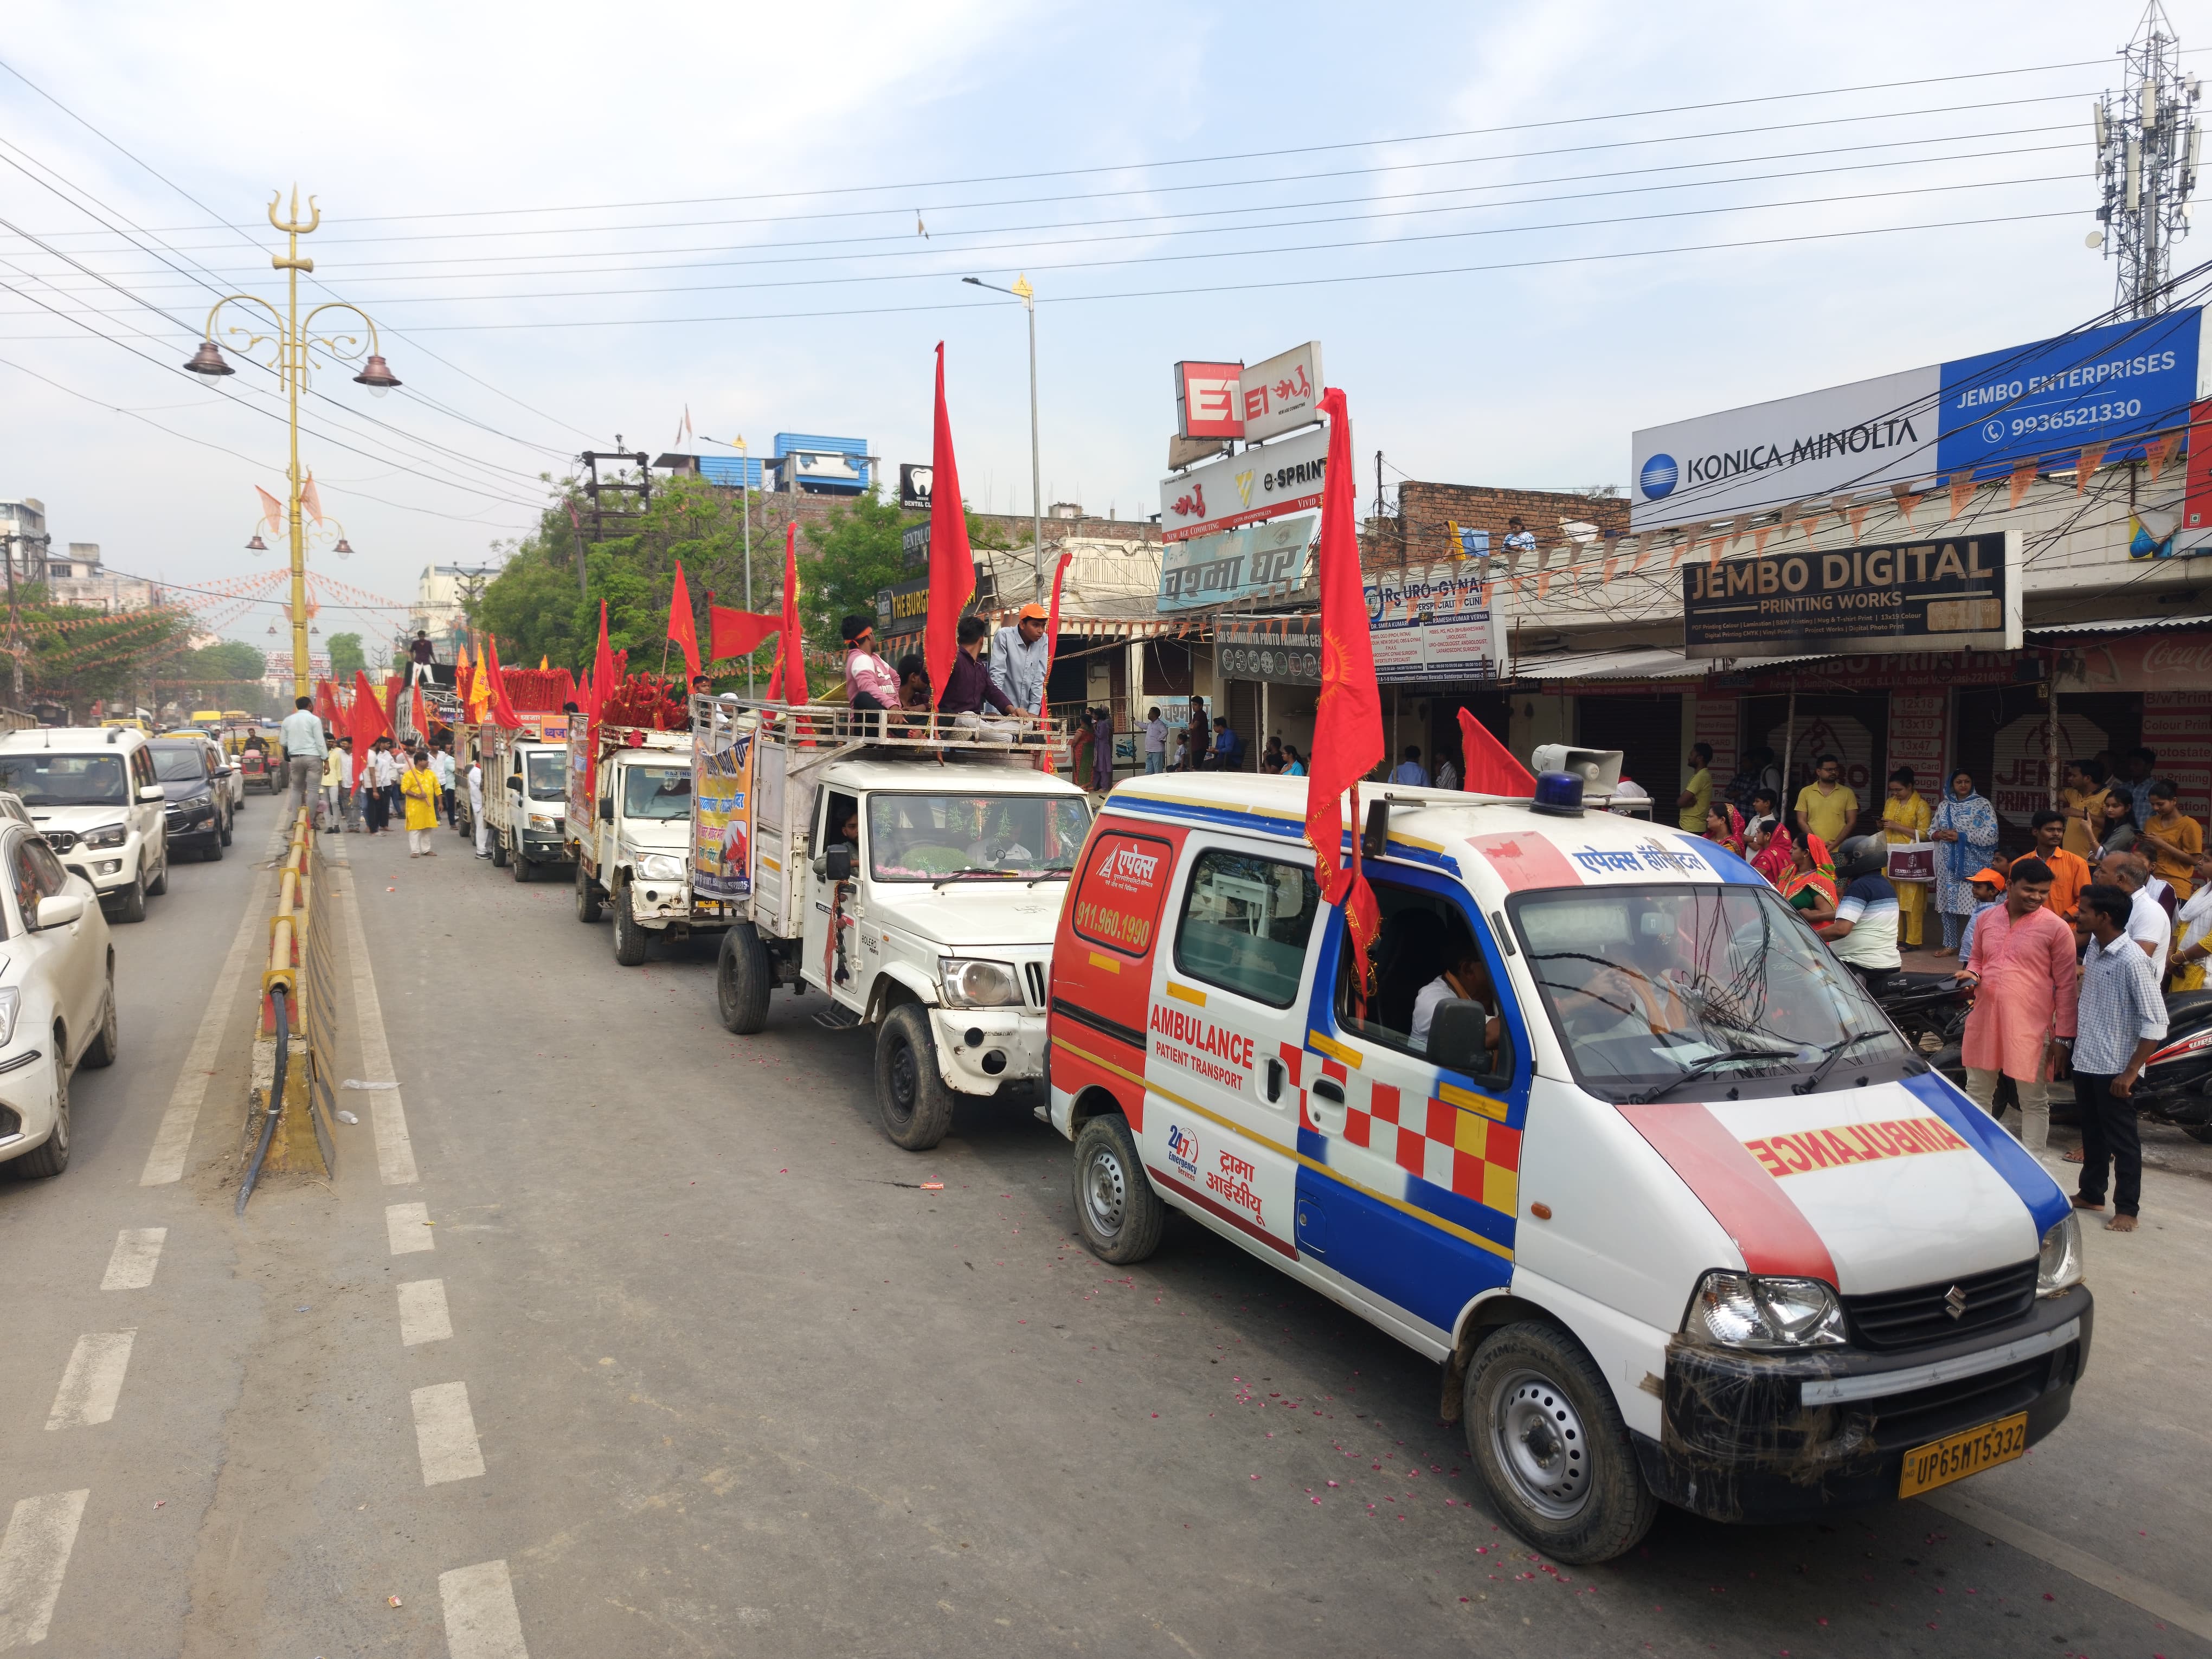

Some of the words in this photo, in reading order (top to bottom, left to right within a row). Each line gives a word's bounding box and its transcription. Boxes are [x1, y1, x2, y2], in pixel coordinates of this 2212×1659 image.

[1957, 381, 2023, 410] JEMBO
[2029, 350, 2176, 395] ENTERPRISES
[2011, 398, 2141, 436] 9936521330
[1687, 442, 1784, 484] KONICA
[1790, 417, 1918, 465] MINOLTA
[903, 528, 924, 550] DENTAL
[1165, 555, 1245, 600] चश्मा
[1249, 544, 1302, 586] घर
[1692, 557, 1810, 600] JEMBO
[1822, 541, 1994, 590] DIGITAL
[893, 595, 906, 619] THE
[1464, 597, 1483, 607] CLINI
[1760, 594, 1834, 614] PRINTING
[1838, 591, 1902, 609] WORKS
[1791, 618, 1813, 626] Printing
[1705, 631, 1721, 639] Digital
[1906, 675, 1929, 686] Road
[1901, 698, 1934, 709] 12x18
[1899, 718, 1934, 729] 13x19
[2144, 720, 2182, 730] Colour
[1900, 740, 1931, 751] 13x47
[1921, 762, 1940, 770] Card
[2168, 773, 2209, 785] Printing
[2177, 801, 2208, 812] ation
[1117, 844, 1159, 880] एपेक्स
[1571, 845, 1645, 875] एपेक्स
[1077, 901, 1149, 948] 911.960.1990
[861, 935, 877, 949] BOLERO
[1150, 1004, 1255, 1071] AMBULANCE
[1156, 1040, 1188, 1068] PATIENT
[1190, 1055, 1243, 1091] TRANSPORT
[1168, 1150, 1198, 1175] Emergency
[1178, 1166, 1195, 1182] Services
[1219, 1149, 1256, 1183] ट्रामा
[1206, 1171, 1266, 1227] आईसीयू
[1917, 1423, 2024, 1485] UP65MT5332
